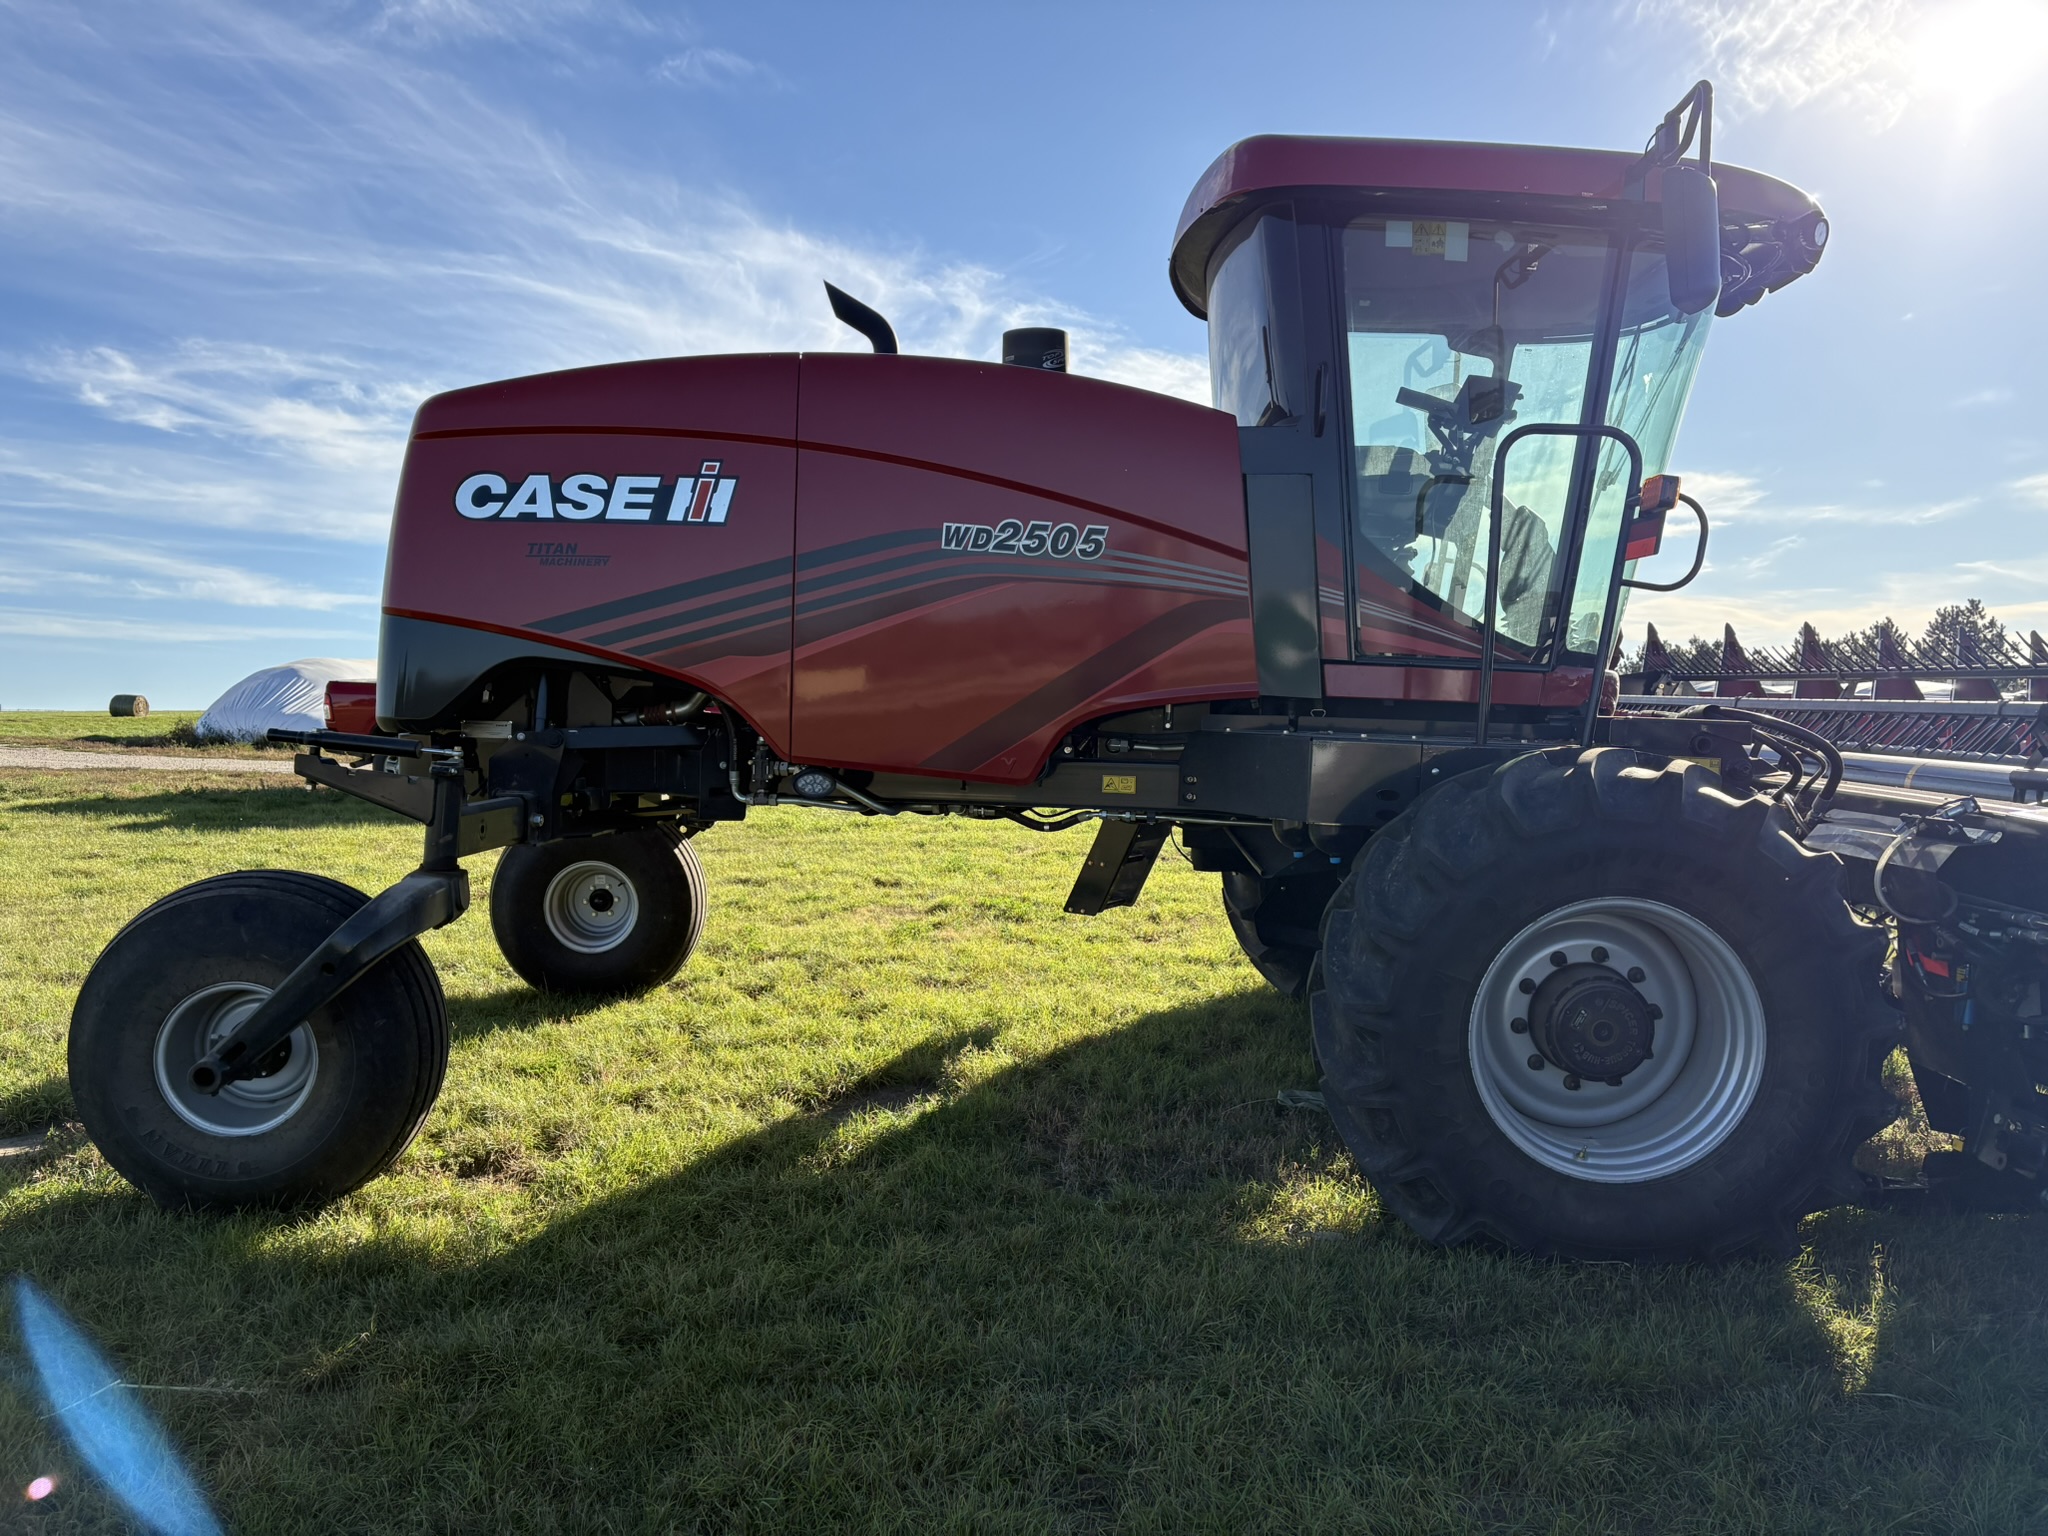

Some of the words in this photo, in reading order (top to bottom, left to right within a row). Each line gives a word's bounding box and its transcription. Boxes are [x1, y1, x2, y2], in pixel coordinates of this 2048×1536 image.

[454, 473, 662, 520] CASE
[527, 543, 578, 555] TITAN
[941, 518, 1110, 560] WD2505
[539, 557, 609, 567] MACHINERY
